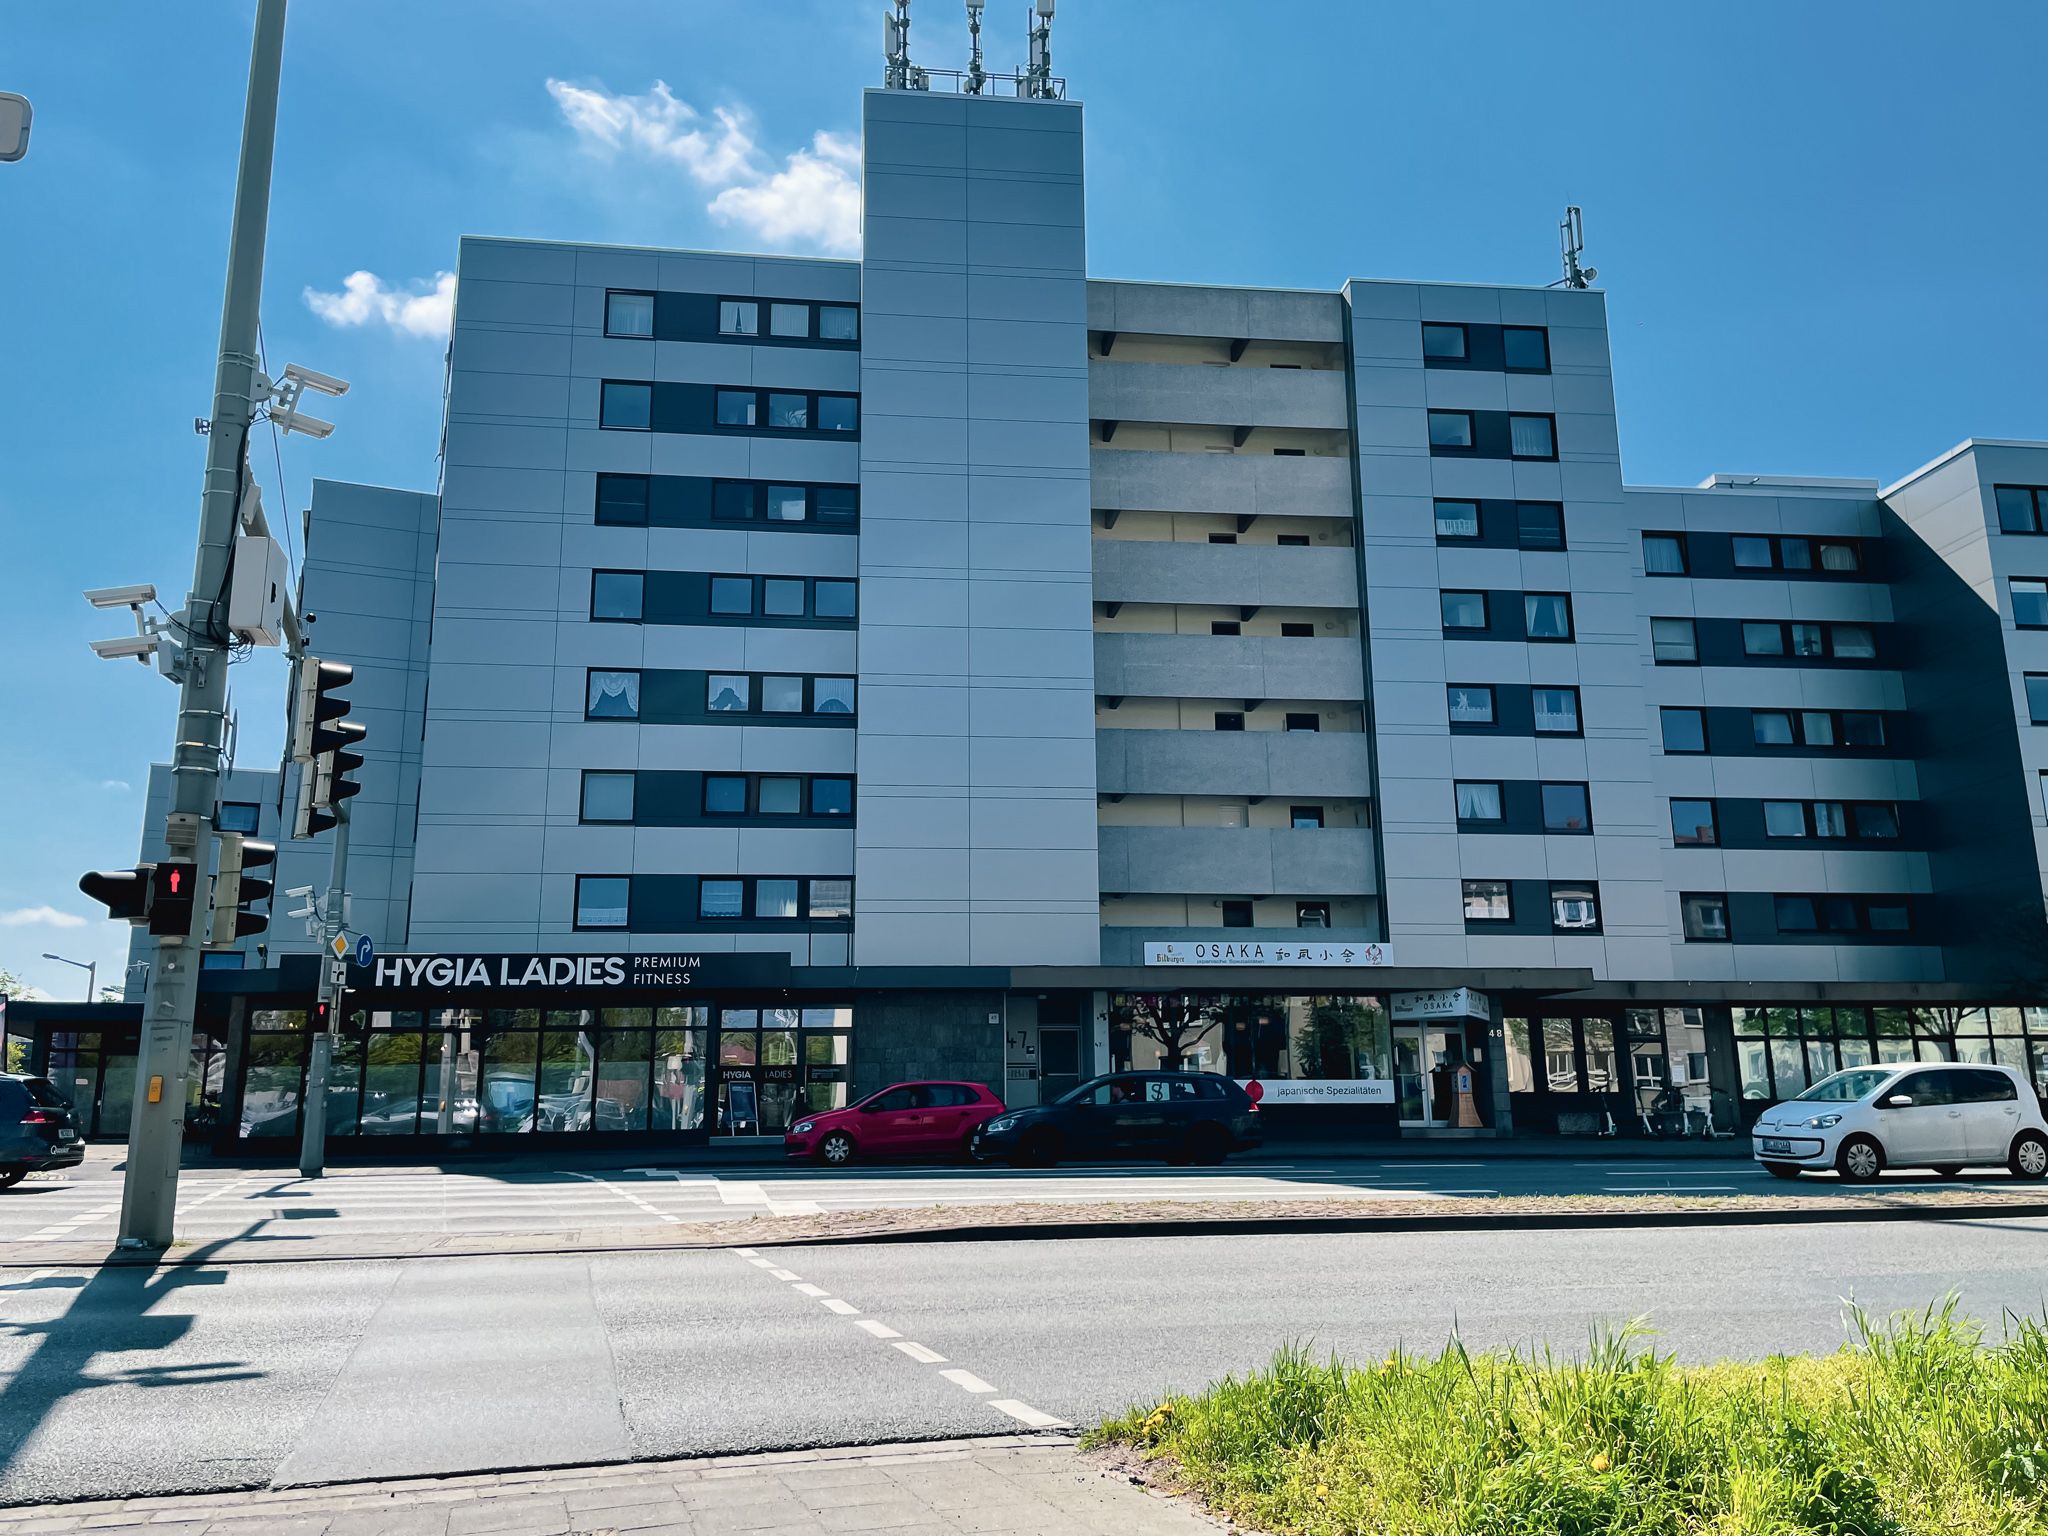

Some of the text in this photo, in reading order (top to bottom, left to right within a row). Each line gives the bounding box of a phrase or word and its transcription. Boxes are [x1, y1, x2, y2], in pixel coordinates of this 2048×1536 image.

[1196, 944, 1264, 958] OSAKA
[634, 956, 701, 968] PREMIUM
[375, 957, 626, 986] HYGIA LADIES
[633, 973, 691, 985] FITNESS
[1423, 1001, 1454, 1010] OSAKA
[1488, 1029, 1503, 1038] 48
[1006, 1030, 1027, 1049] 47
[722, 1070, 752, 1079] HYGIA
[764, 1070, 793, 1079] LADIES
[1277, 1086, 1382, 1097] japanische Spezialitäten
